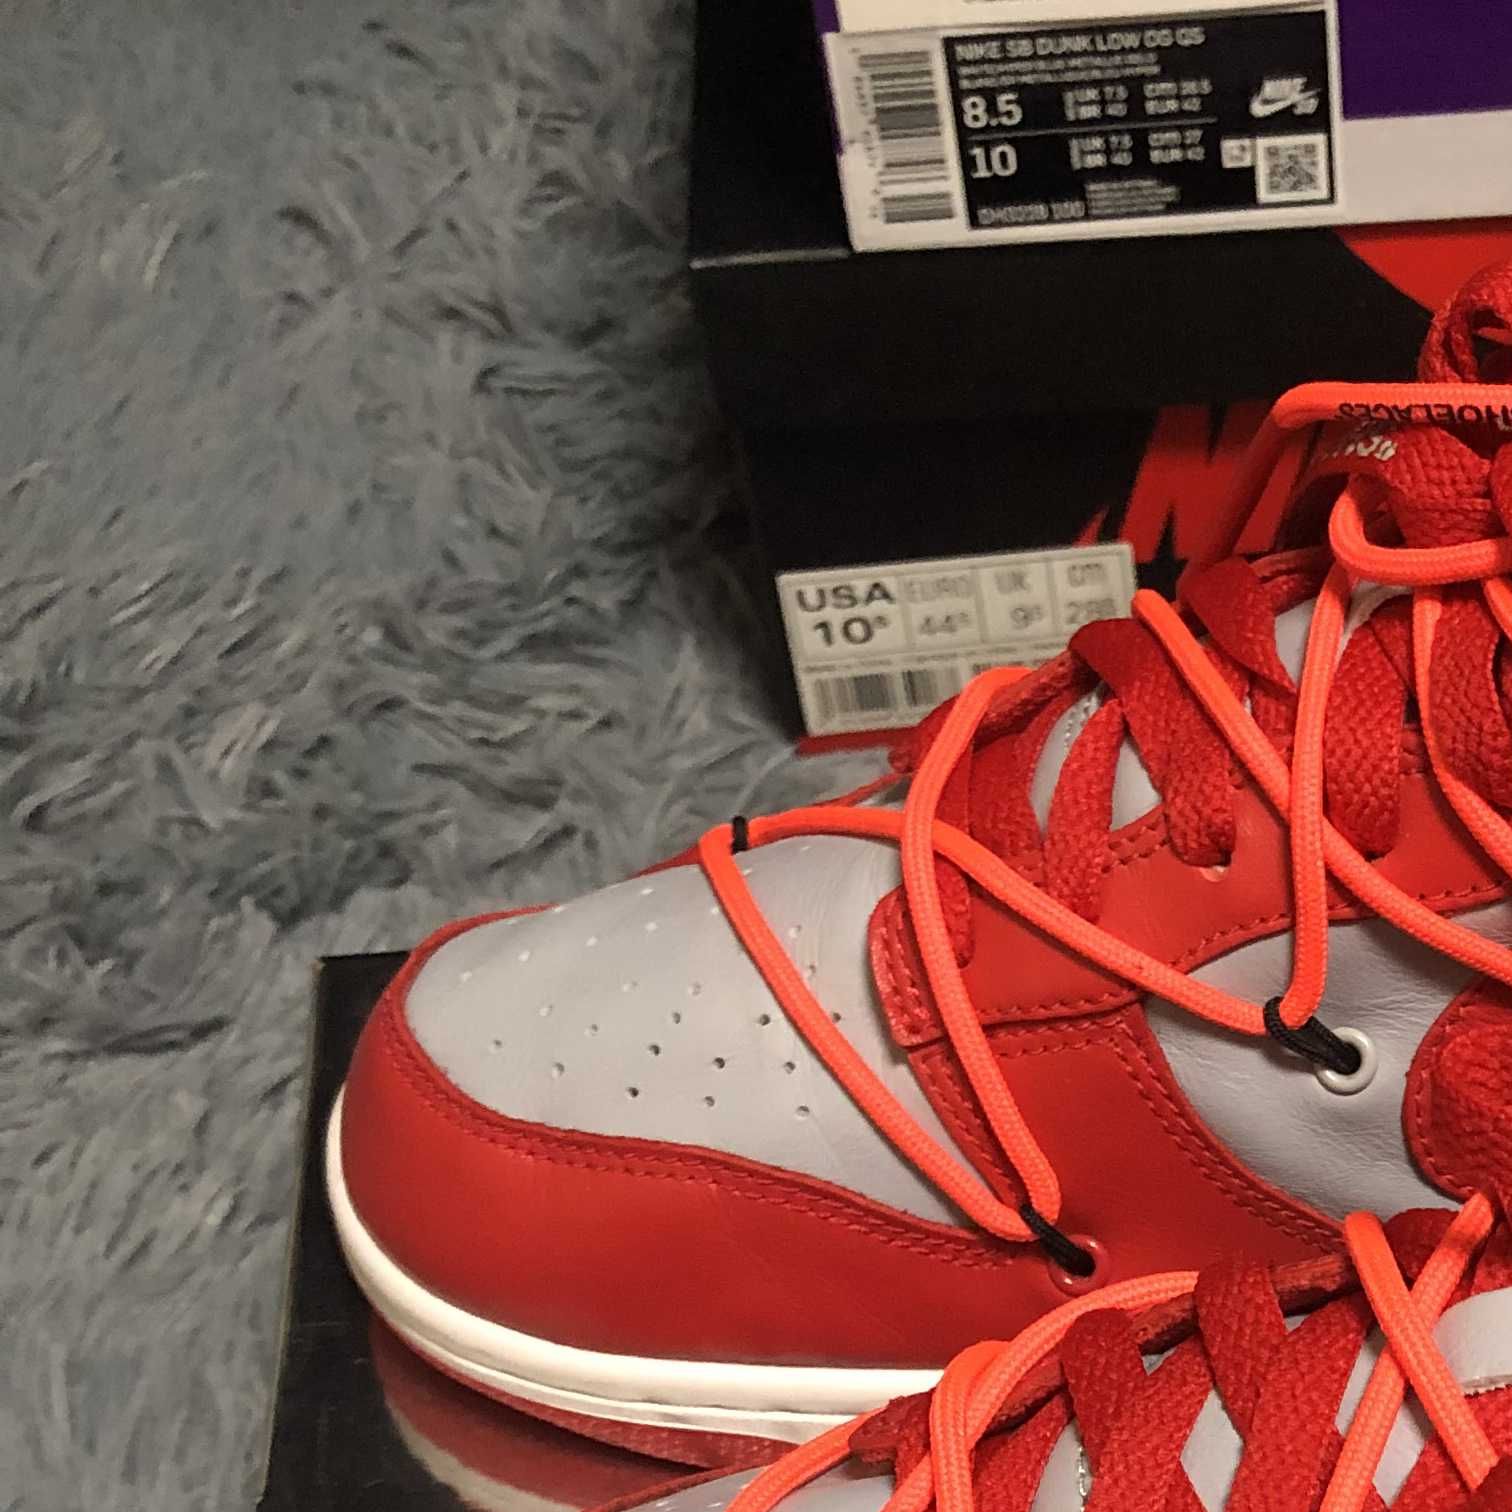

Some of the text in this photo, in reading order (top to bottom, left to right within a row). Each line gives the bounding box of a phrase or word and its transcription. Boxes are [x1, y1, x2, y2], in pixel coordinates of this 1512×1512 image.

[961, 92, 1024, 129] 8.5
[968, 142, 1018, 179] 10
[796, 581, 896, 613] USA
